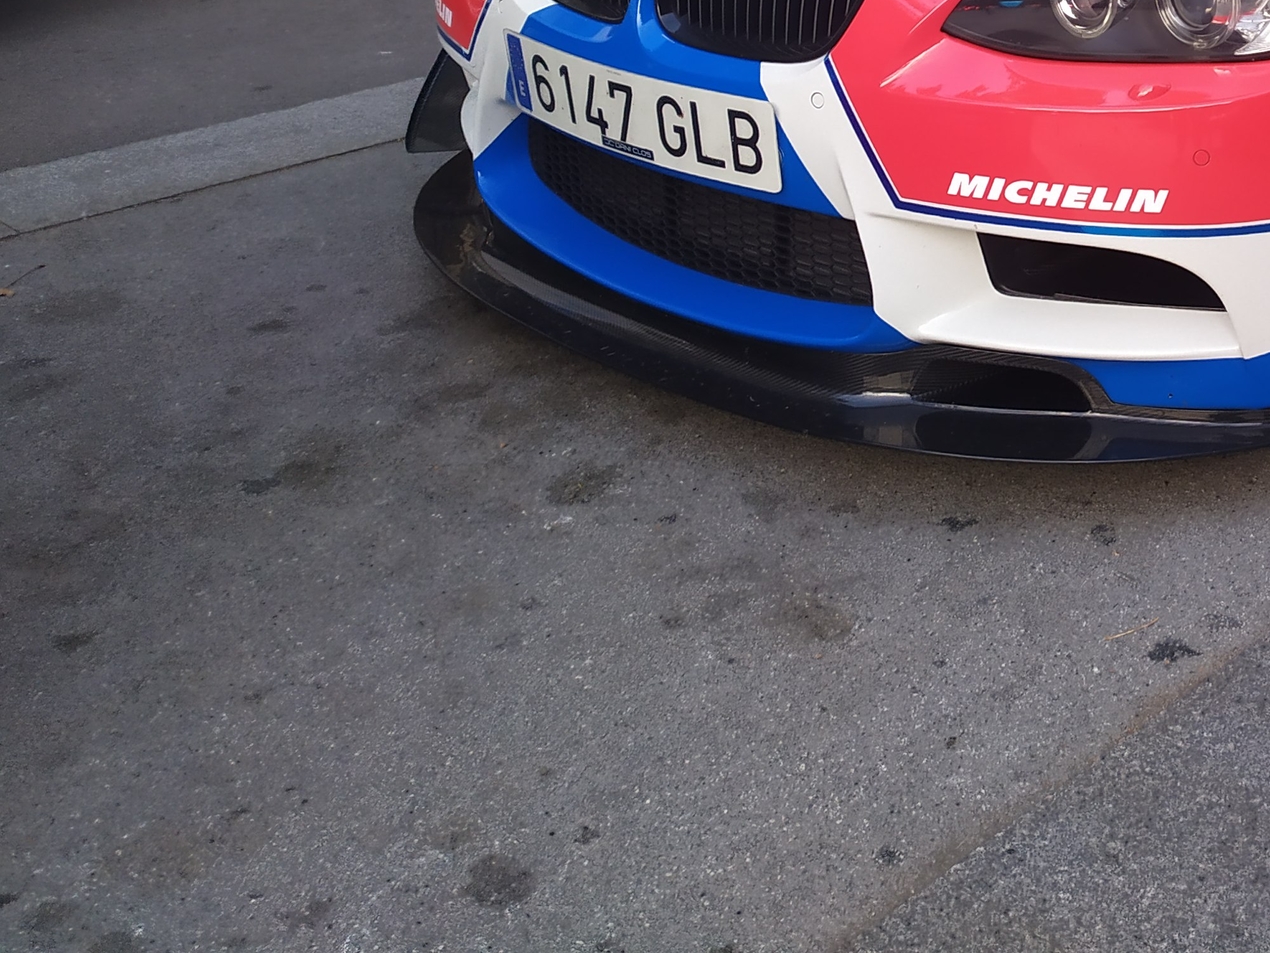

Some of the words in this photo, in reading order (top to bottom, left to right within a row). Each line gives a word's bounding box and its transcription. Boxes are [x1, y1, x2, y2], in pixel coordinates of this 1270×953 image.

[518, 79, 526, 97] E
[531, 54, 633, 142] 6147
[656, 95, 763, 175] GLB
[632, 147, 652, 158] CLOS
[947, 172, 1170, 214] MICHELIN
